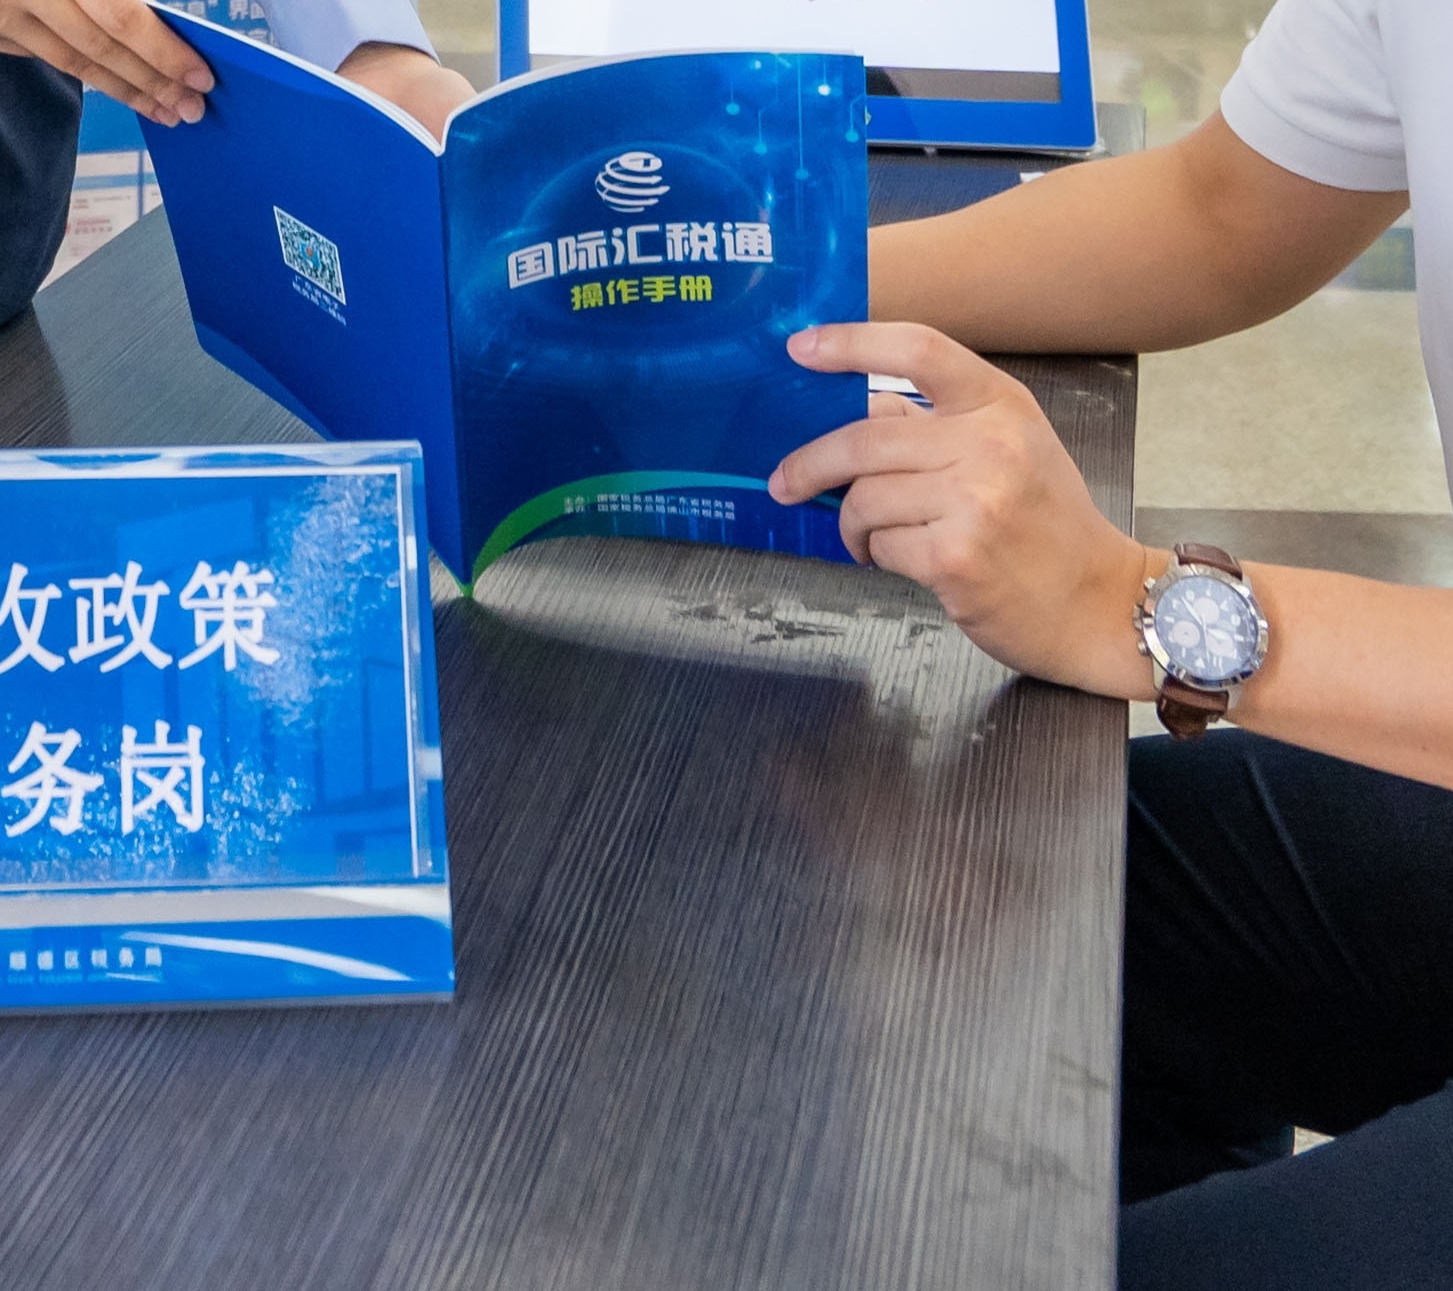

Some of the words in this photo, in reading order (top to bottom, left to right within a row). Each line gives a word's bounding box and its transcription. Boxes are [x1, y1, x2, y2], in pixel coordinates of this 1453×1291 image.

[506, 220, 775, 292] 国际汇税通
[568, 274, 713, 313] 操作手册
